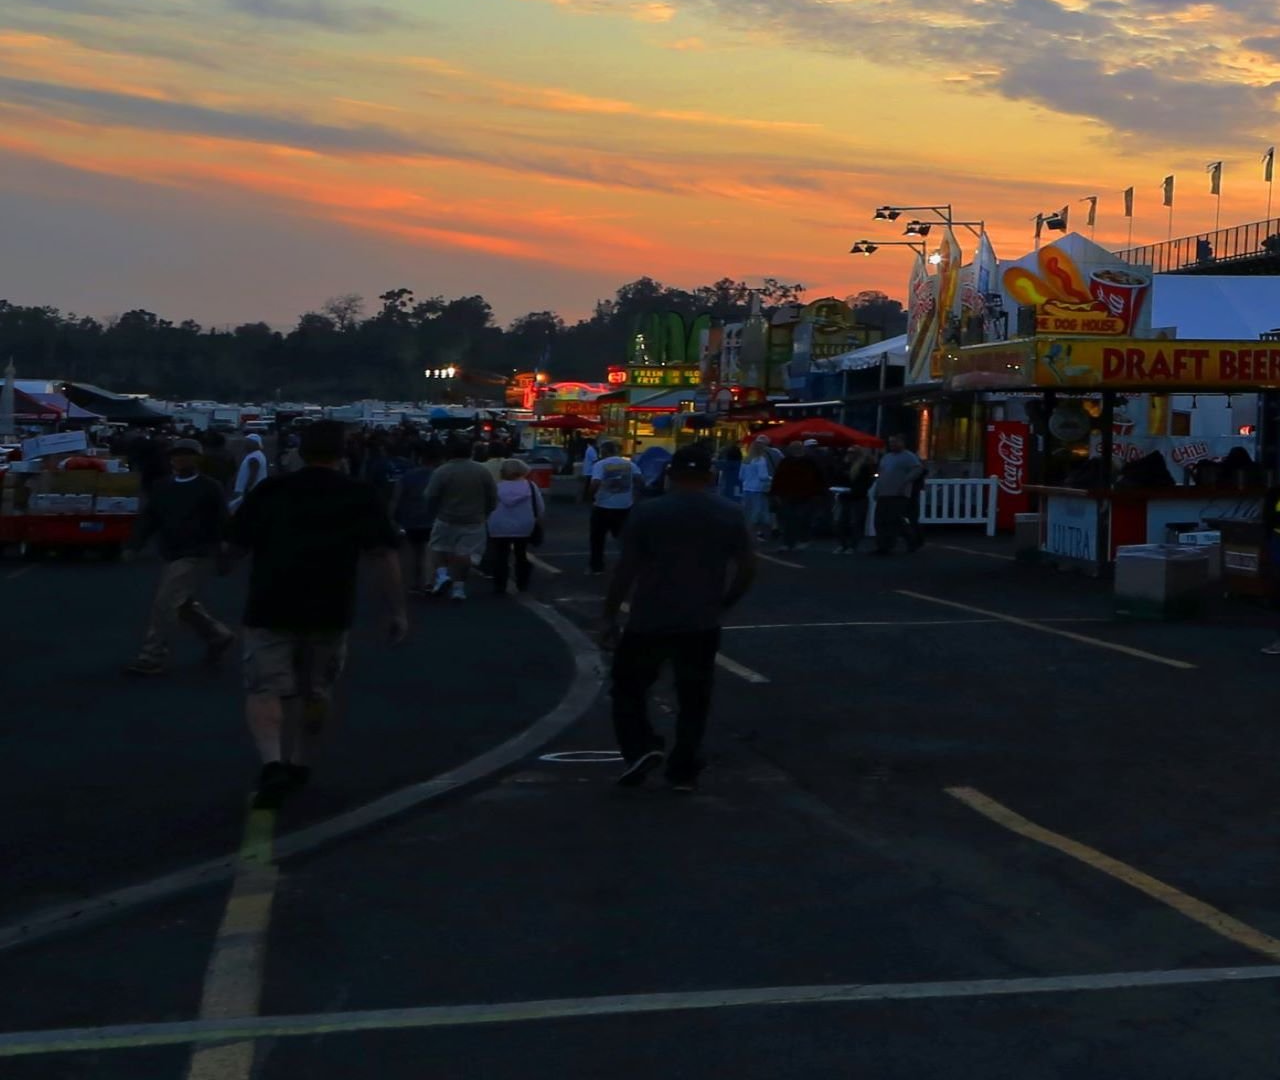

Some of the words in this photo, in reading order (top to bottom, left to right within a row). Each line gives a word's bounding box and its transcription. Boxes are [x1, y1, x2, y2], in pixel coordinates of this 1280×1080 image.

[1034, 318, 1049, 330] HE
[1102, 348, 1210, 380] DRAFT
[998, 431, 1024, 495] Coca-Cola
[1052, 523, 1090, 560] ULTRA
